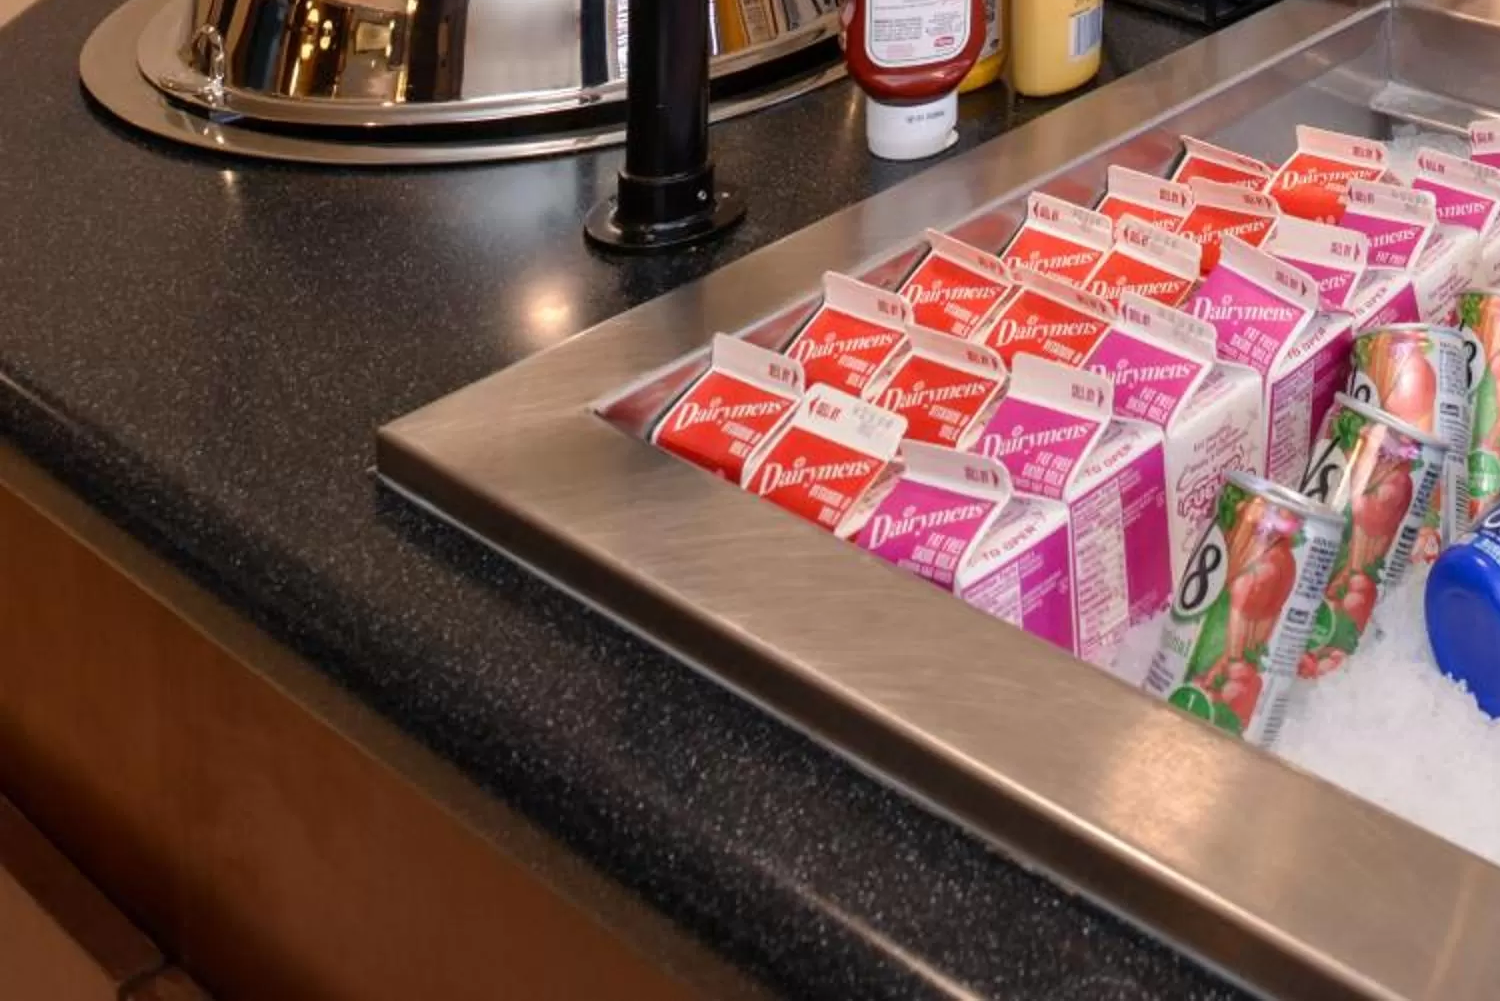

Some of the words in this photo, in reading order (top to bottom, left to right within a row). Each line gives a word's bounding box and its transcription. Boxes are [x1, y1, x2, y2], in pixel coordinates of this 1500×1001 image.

[907, 279, 995, 305] Dairymens
[1194, 295, 1294, 326] Dairymens
[799, 331, 893, 363] Dairymens
[995, 314, 1098, 348] Dairymens
[884, 380, 986, 412] Dairymens
[673, 396, 784, 432] Dairymens
[983, 424, 1089, 459] Dairymens
[758, 456, 872, 497] Dairymens
[868, 504, 985, 550] Dairymens
